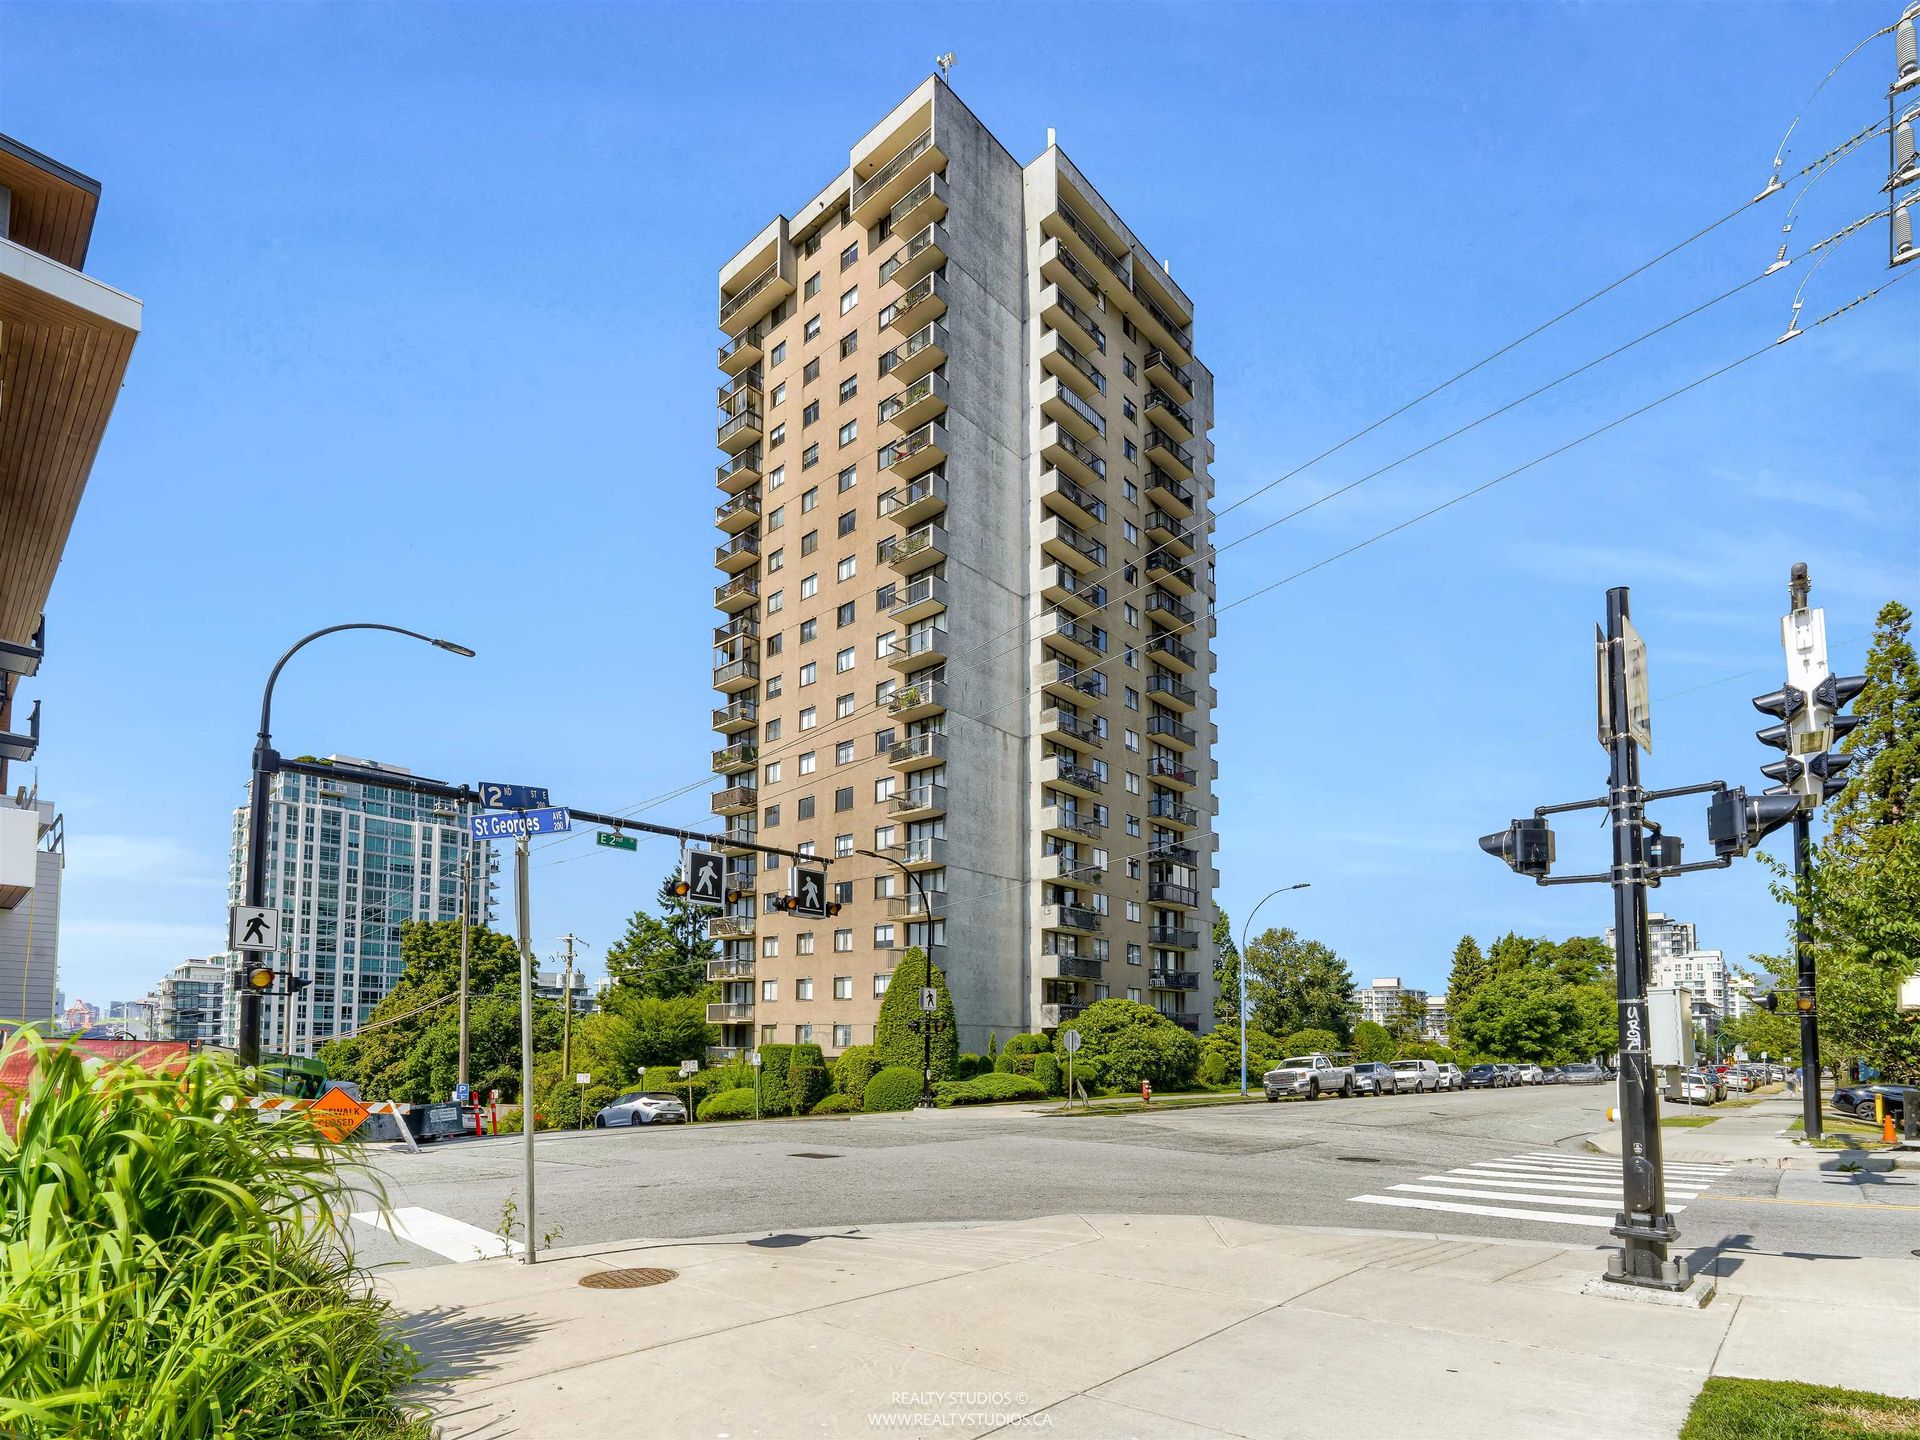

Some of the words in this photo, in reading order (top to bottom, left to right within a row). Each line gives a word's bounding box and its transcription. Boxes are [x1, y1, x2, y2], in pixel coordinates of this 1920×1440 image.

[530, 790, 537, 799] ST
[542, 791, 547, 799] E
[552, 811, 562, 821] AVE
[474, 818, 489, 836] St
[491, 816, 540, 837] Georges
[553, 821, 564, 831] 200
[600, 833, 607, 844] E
[609, 835, 624, 846] 2nd
[313, 1107, 360, 1117] EWALK
